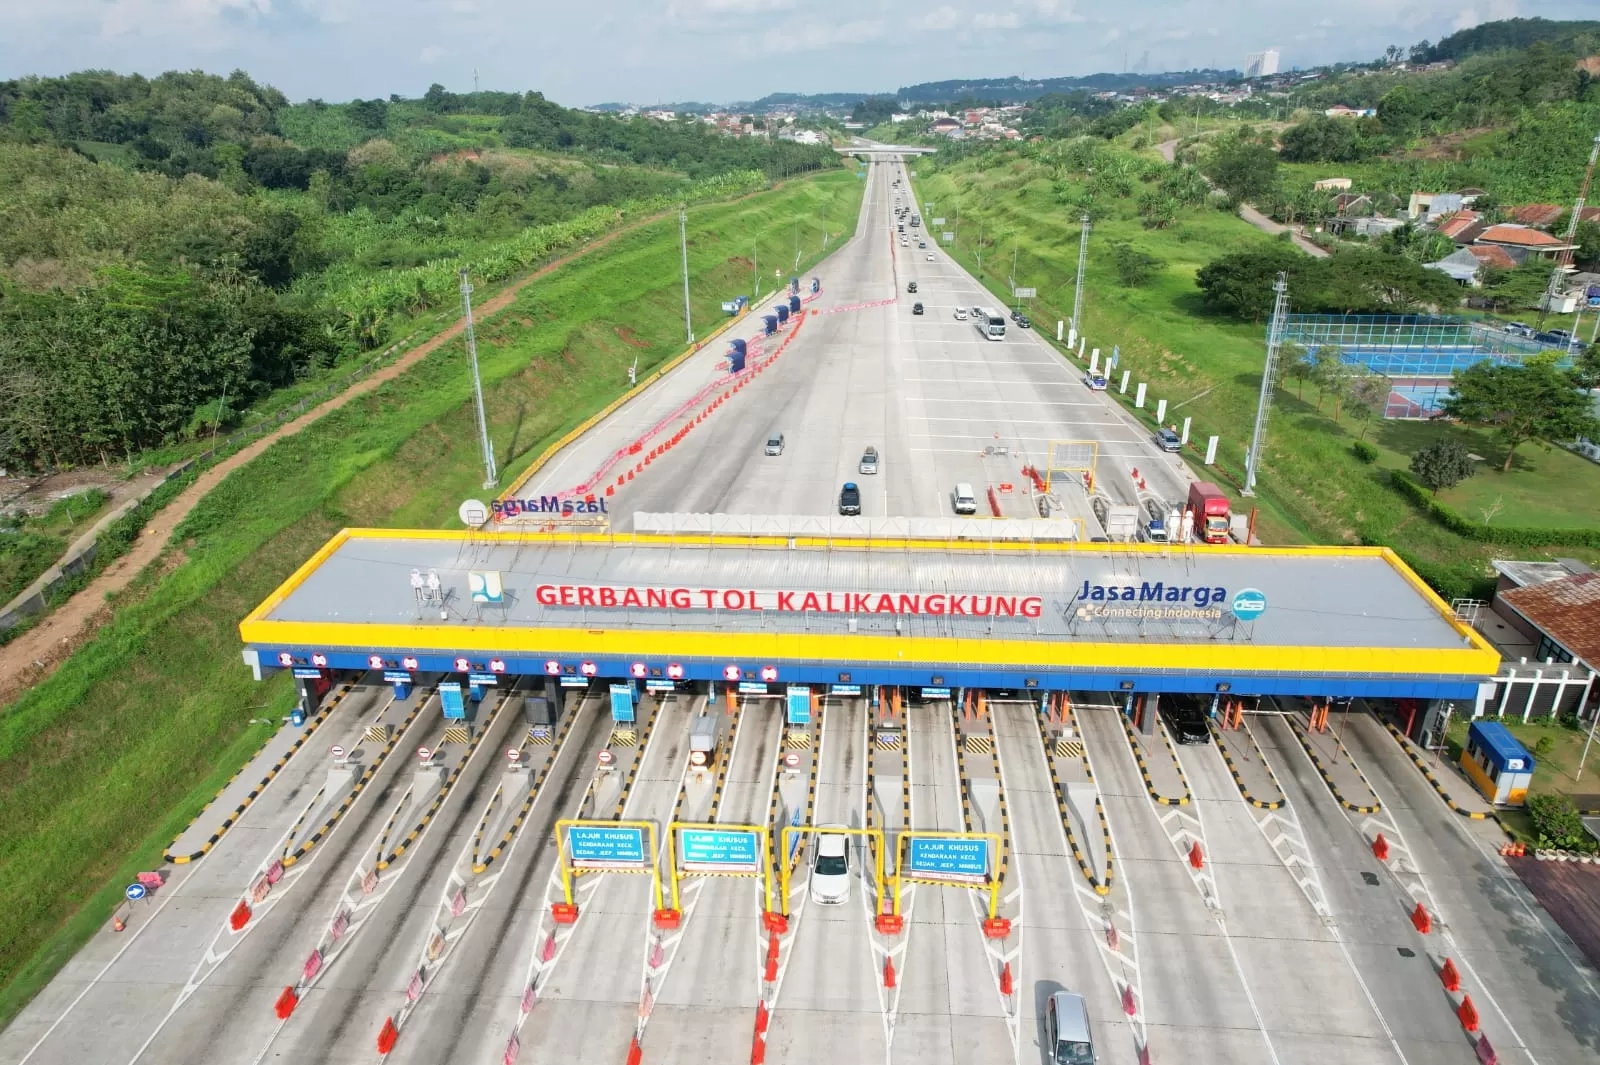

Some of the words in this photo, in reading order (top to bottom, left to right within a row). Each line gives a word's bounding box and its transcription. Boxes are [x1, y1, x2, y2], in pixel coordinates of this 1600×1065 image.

[536, 585, 691, 609] GERBANG
[700, 589, 764, 611] TOL
[777, 591, 1042, 618] KALIKANGKUNG
[1094, 606, 1162, 619] Connecting
[1164, 607, 1222, 619] Indonesia
[919, 852, 957, 860] KENDARAAN
